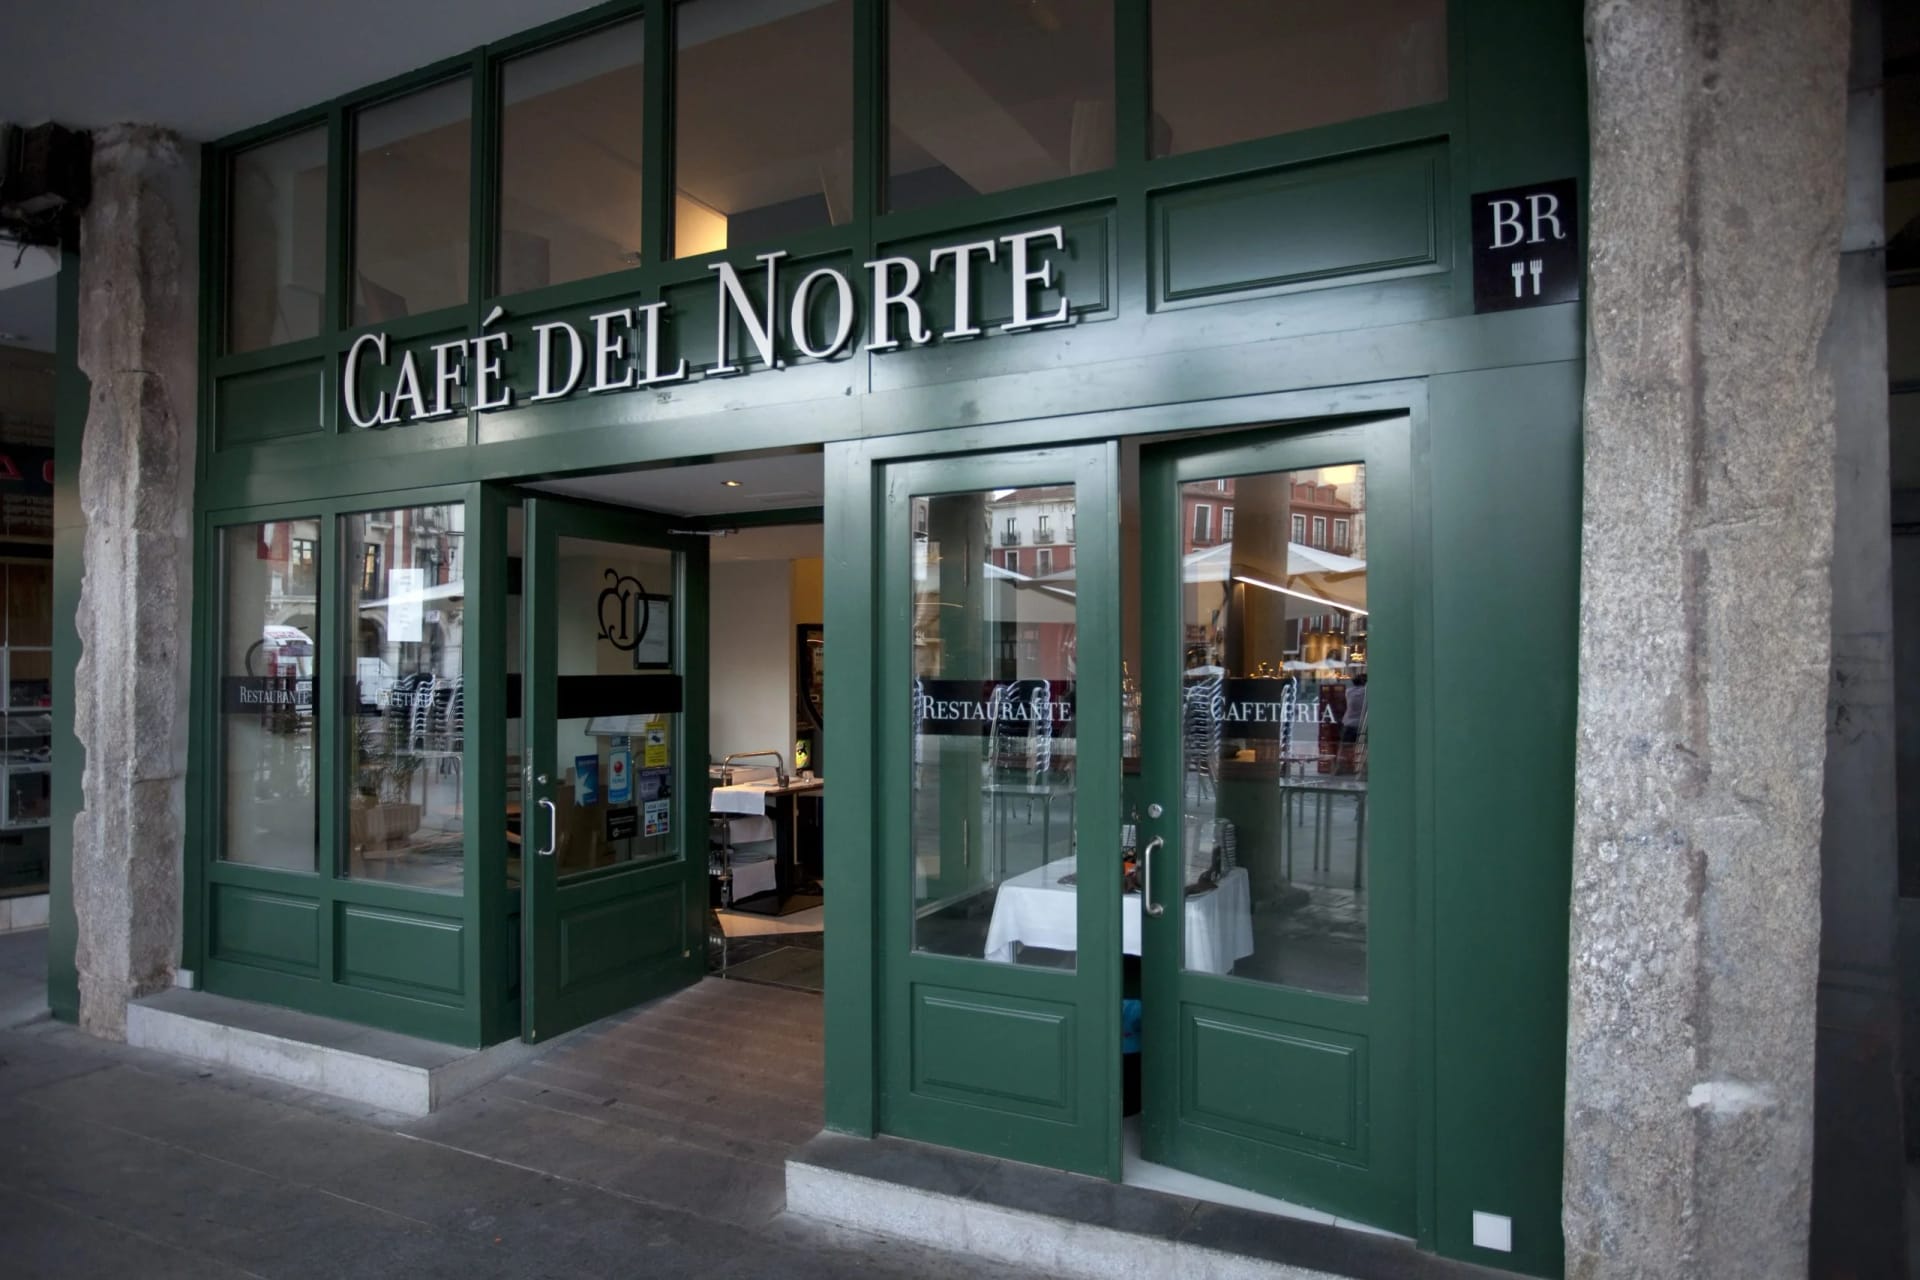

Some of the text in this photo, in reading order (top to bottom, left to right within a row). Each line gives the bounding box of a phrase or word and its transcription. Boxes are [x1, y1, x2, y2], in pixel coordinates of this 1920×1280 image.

[1487, 193, 1566, 250] BR
[344, 224, 1070, 428] CAFÉ DEL NORTE
[240, 686, 310, 705] RESTAURANTE
[375, 687, 436, 707] CAFETEA
[922, 695, 1072, 721] RESTAURANTE
[1210, 696, 1337, 723] CAFETERÍA
